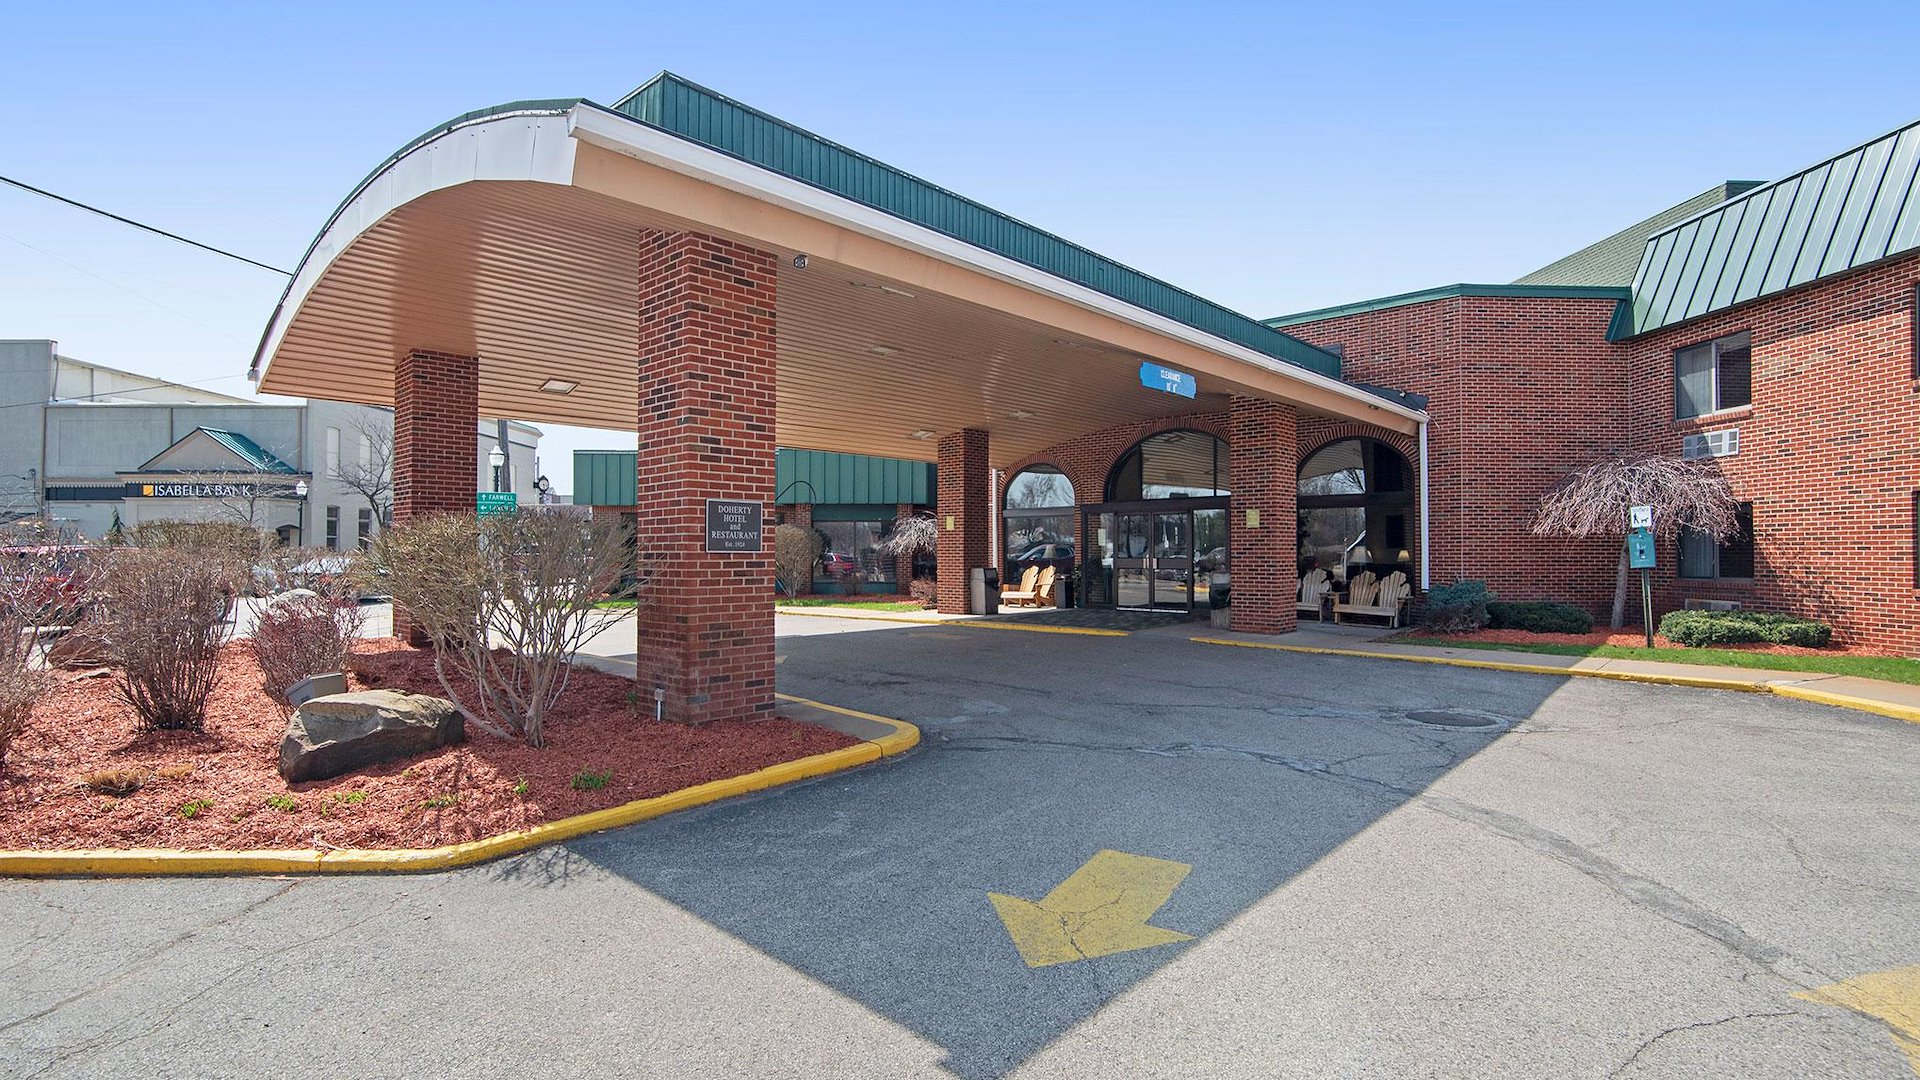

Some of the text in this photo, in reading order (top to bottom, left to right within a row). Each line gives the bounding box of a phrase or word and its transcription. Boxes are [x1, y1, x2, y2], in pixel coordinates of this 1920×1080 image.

[154, 484, 252, 498] ISABELLA BANK
[718, 505, 752, 514] DOHERTY
[723, 514, 747, 523] HOTEL
[729, 523, 741, 531] and
[711, 530, 759, 539] RESTAURANT
